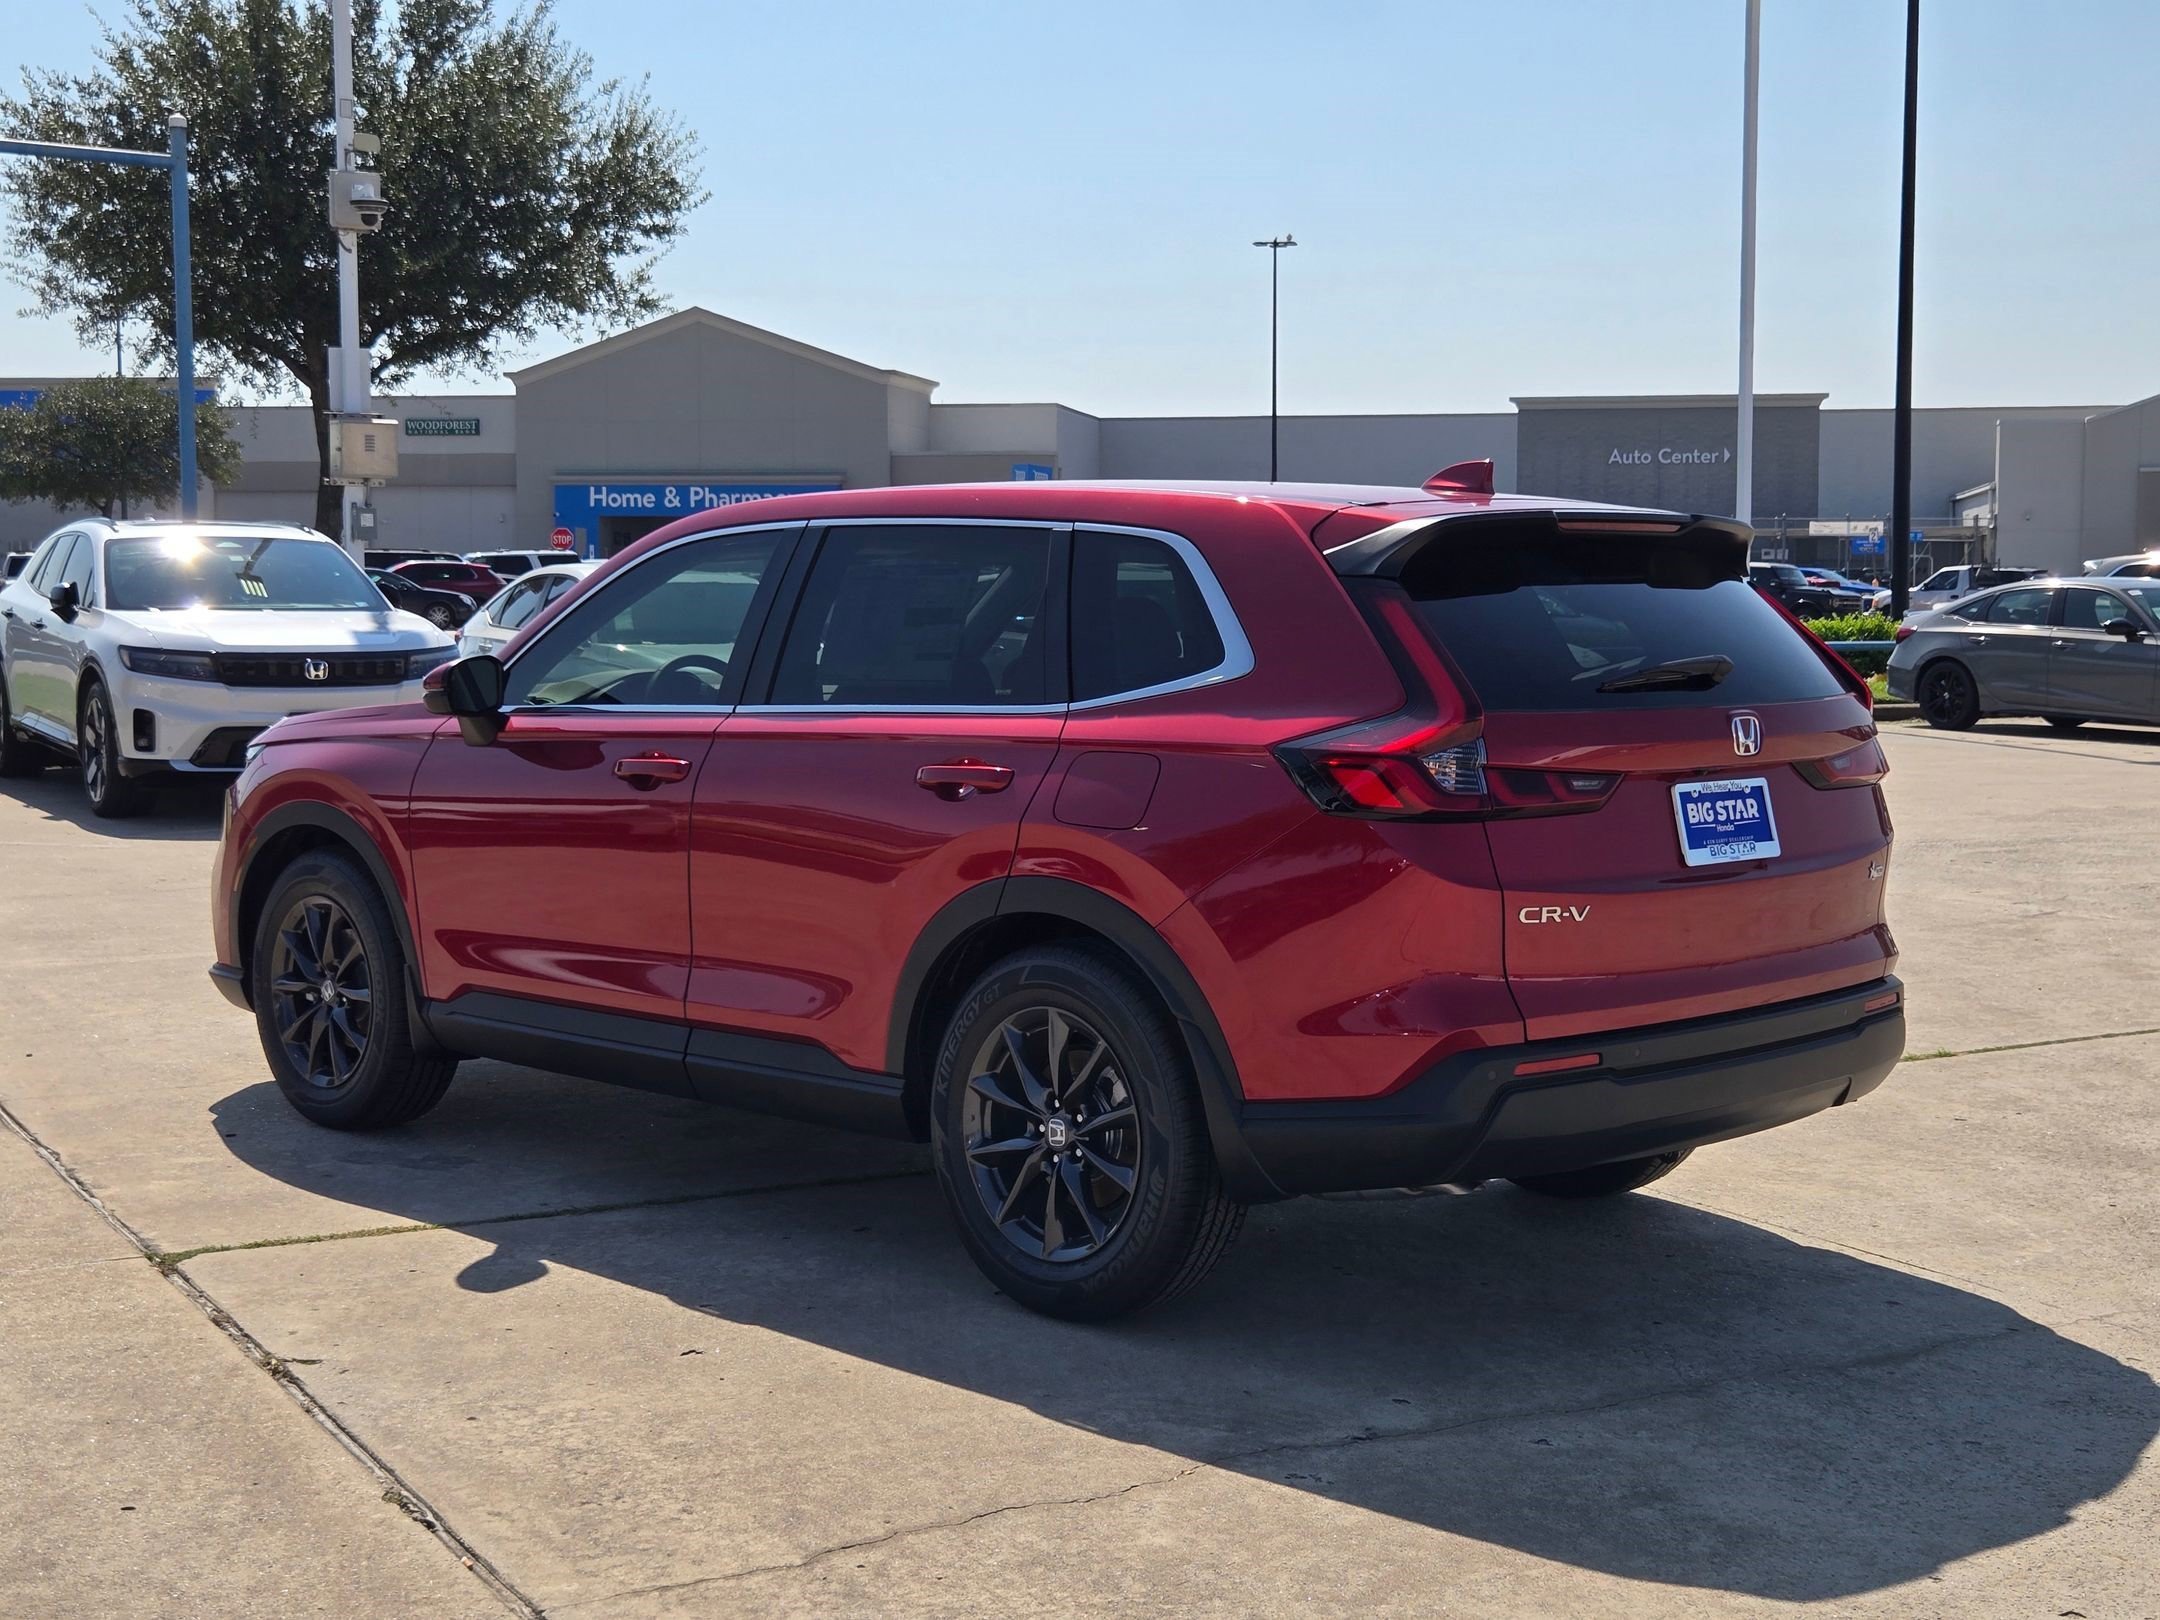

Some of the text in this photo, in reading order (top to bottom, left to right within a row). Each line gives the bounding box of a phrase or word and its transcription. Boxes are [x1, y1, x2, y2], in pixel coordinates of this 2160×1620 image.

[407, 421, 477, 430] WOODFOREST
[1608, 448, 1719, 465] Auto Center
[589, 486, 655, 508] Home
[664, 486, 681, 508] &
[553, 535, 572, 545] STOP
[1701, 783, 1712, 791] We
[1729, 781, 1742, 789] You
[1686, 798, 1760, 824] BIG STAR
[1716, 823, 1735, 833] Honda
[1709, 842, 1757, 857] BIG STAR
[1518, 904, 1591, 923] CR-V
